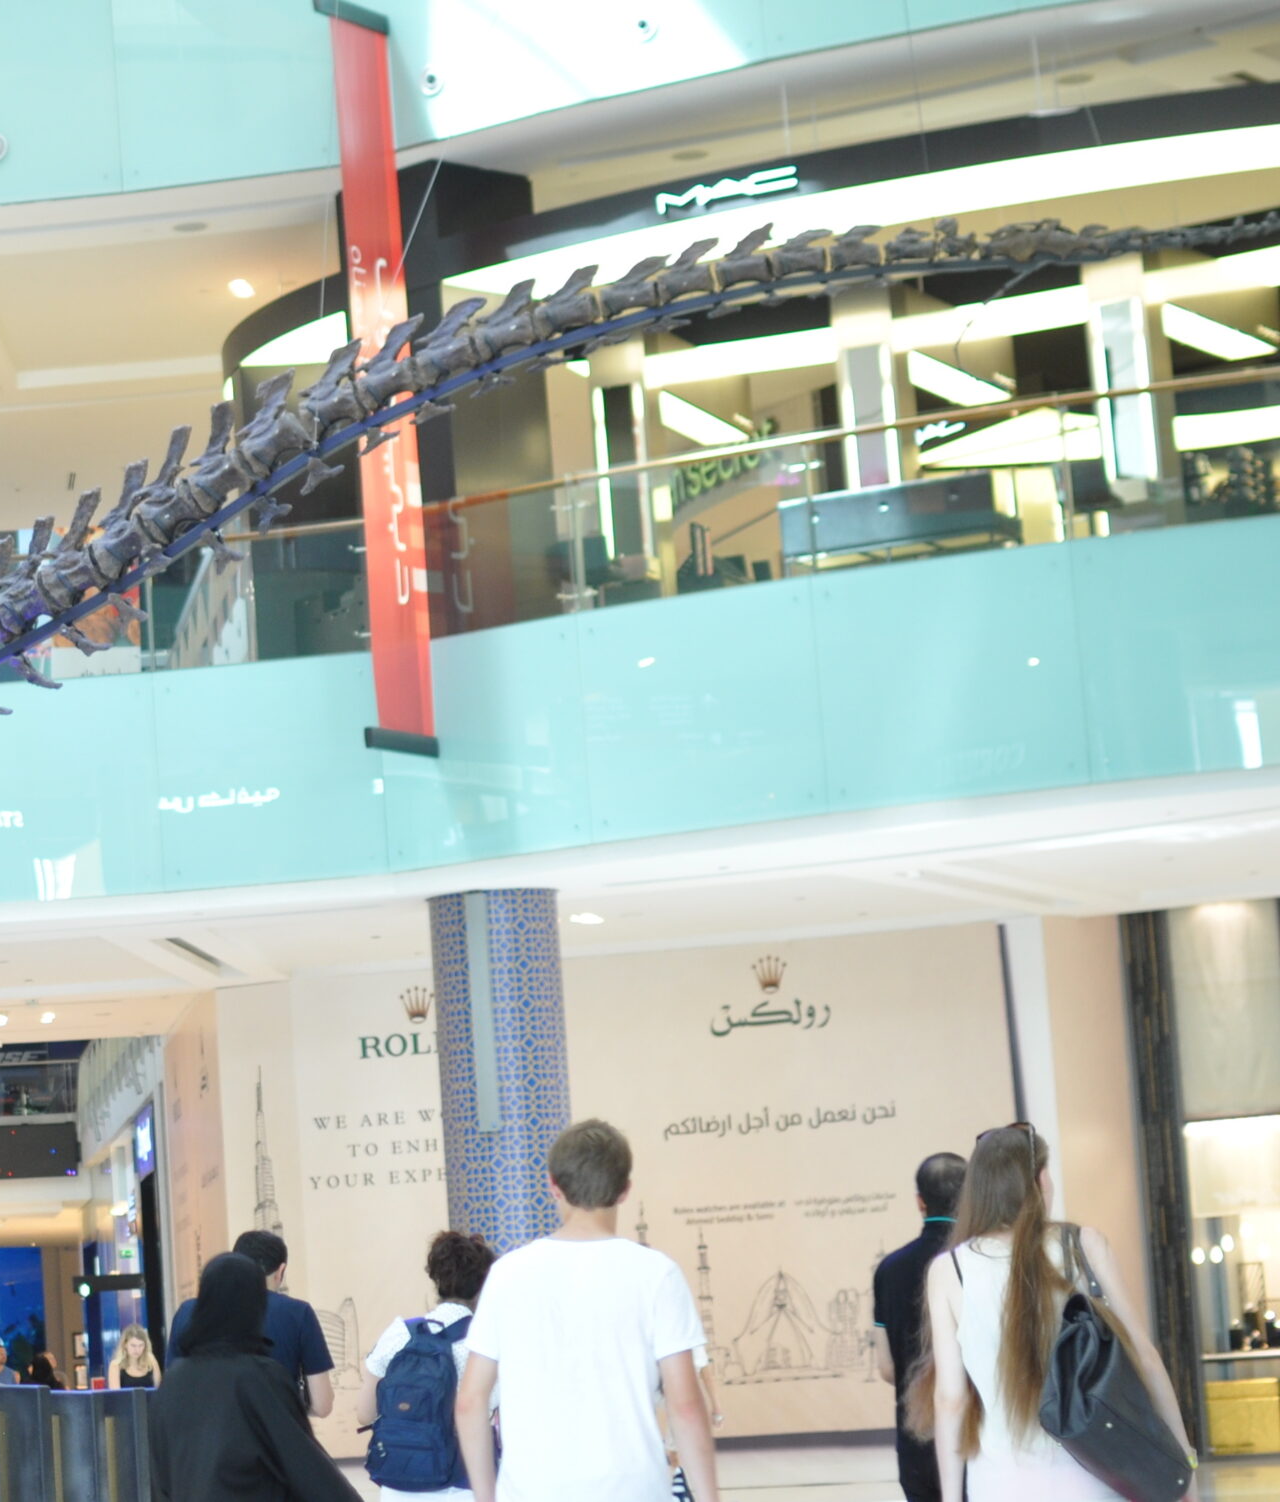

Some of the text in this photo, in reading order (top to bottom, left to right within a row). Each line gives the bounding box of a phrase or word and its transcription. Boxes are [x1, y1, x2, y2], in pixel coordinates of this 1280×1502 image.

[656, 165, 798, 215] MAC
[358, 1031, 438, 1059] ROL
[314, 1108, 444, 1130] WE ARE W
[347, 1138, 438, 1157] TO ENH
[309, 1172, 375, 1190] YOUR
